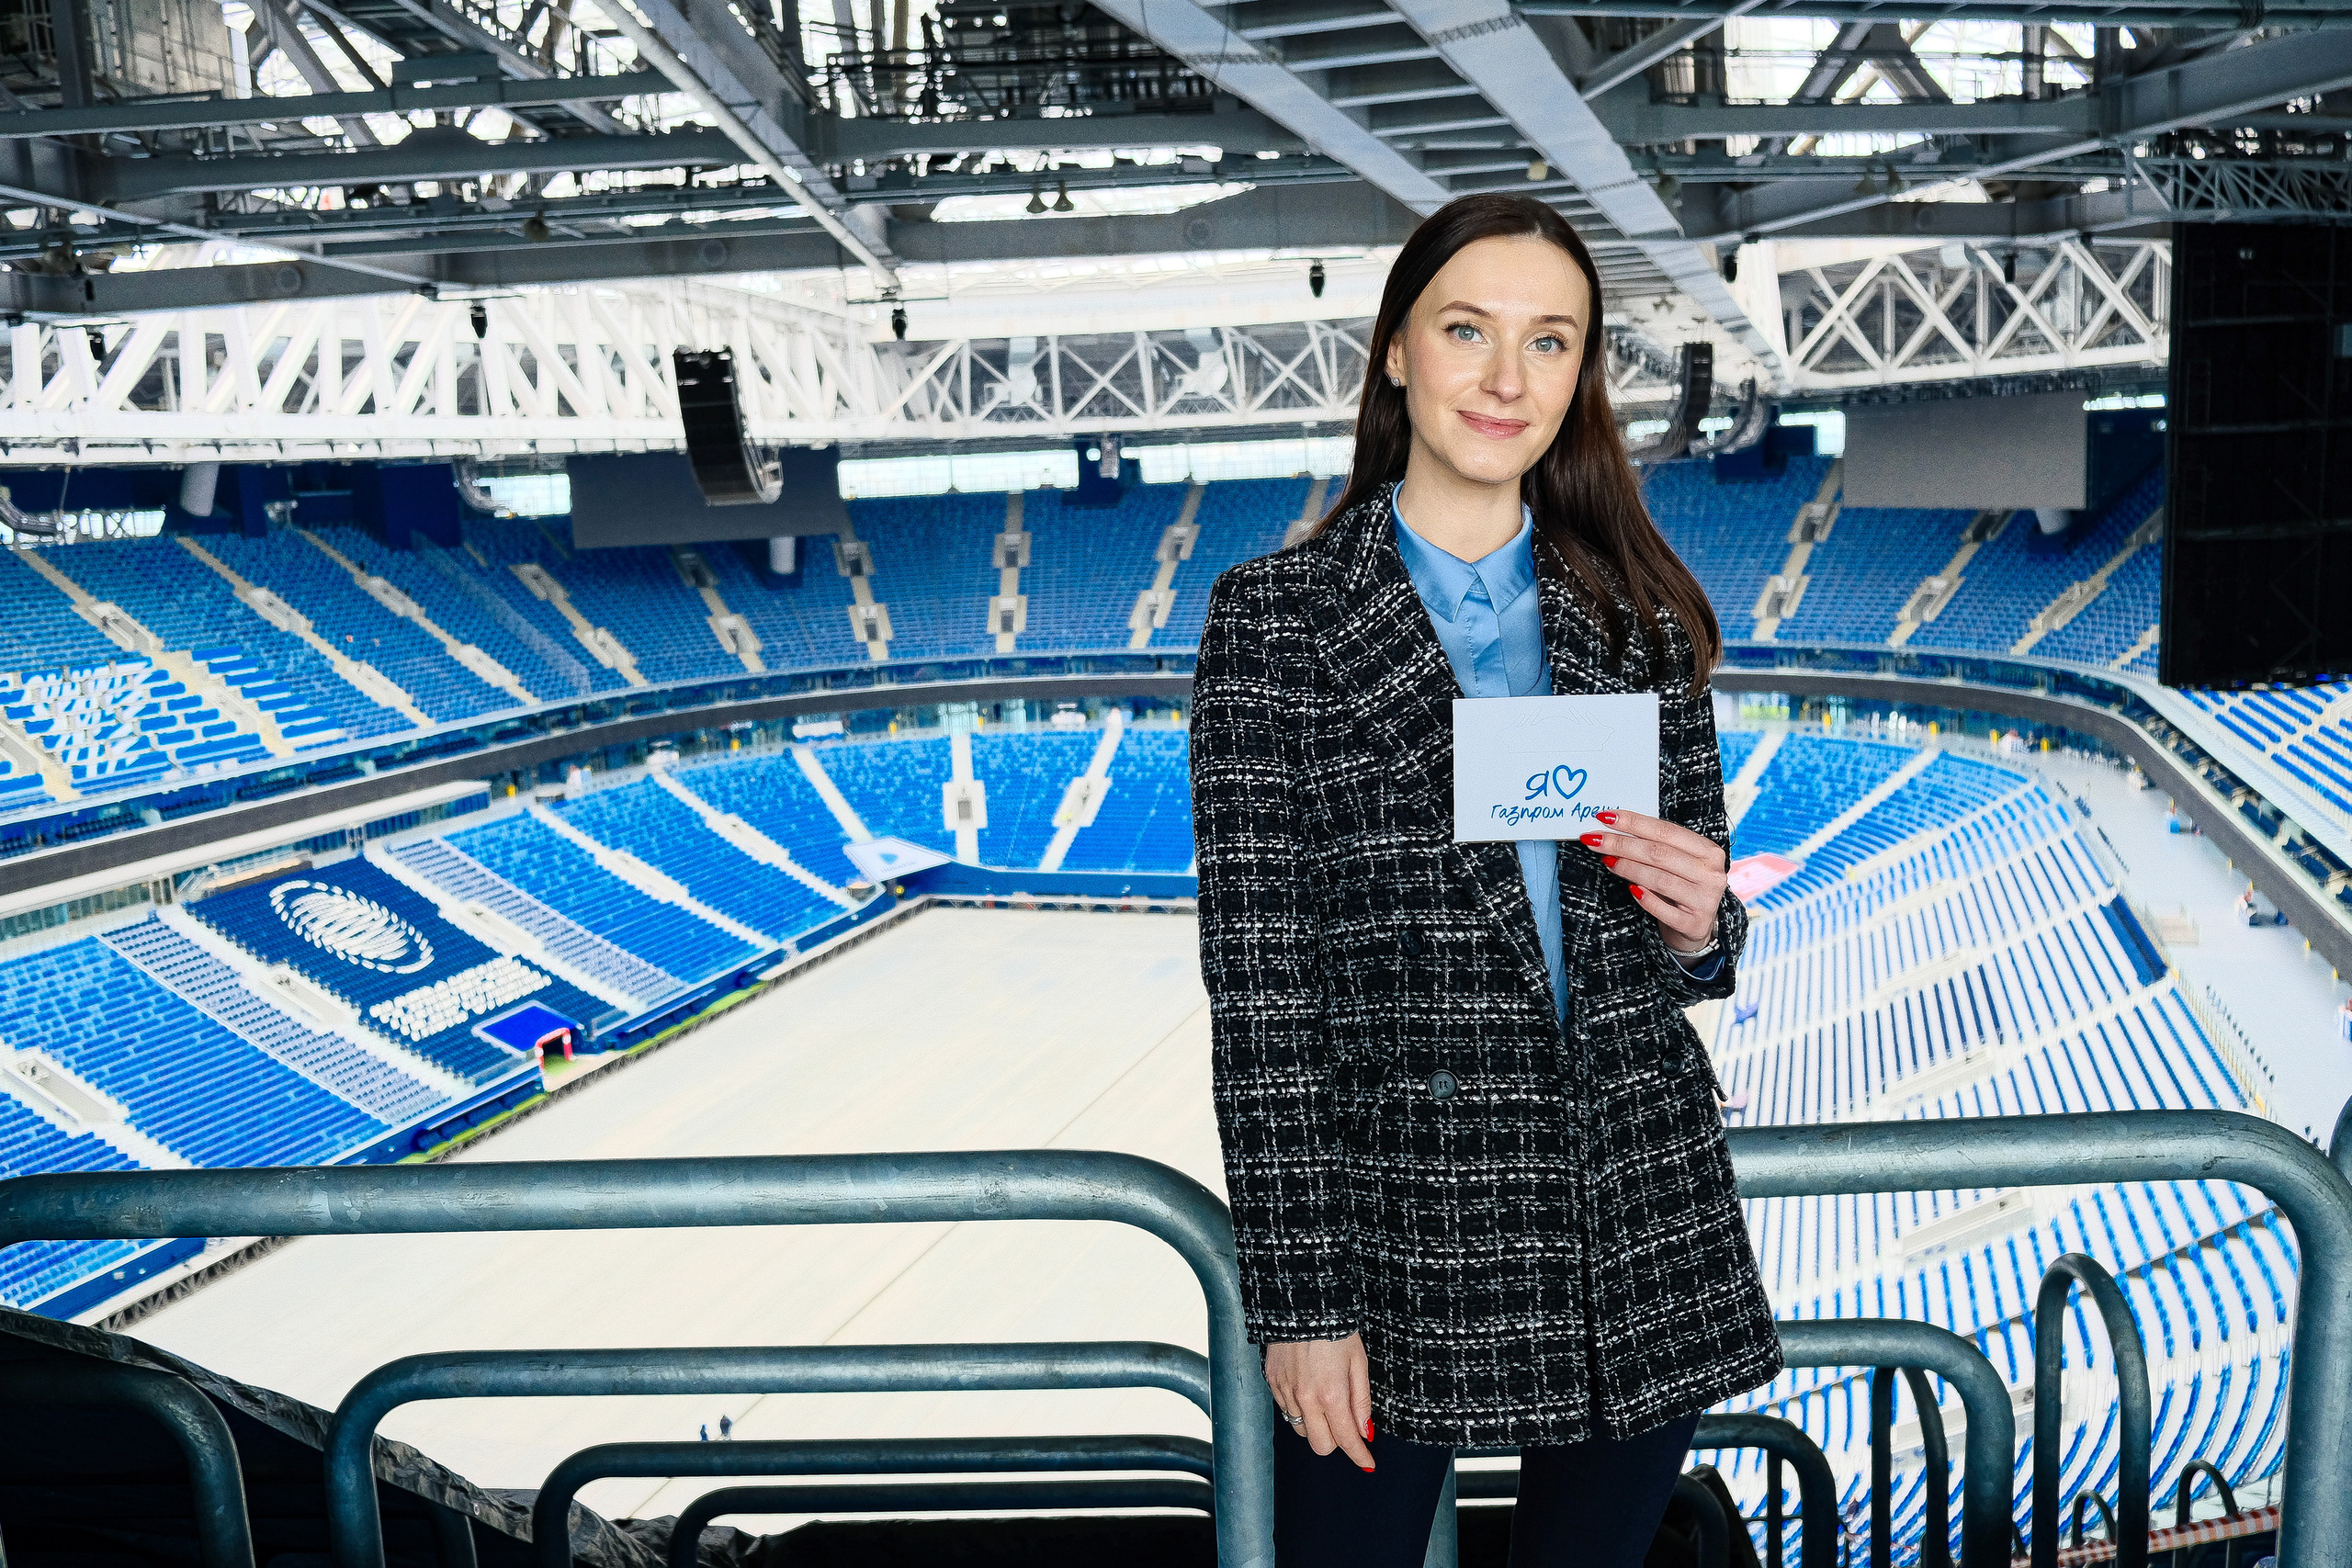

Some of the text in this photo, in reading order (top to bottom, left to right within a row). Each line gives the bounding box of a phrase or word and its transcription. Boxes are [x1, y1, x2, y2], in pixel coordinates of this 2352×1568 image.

[1524, 770, 1550, 801] Я
[1490, 802, 1620, 826] Газпром Аре
